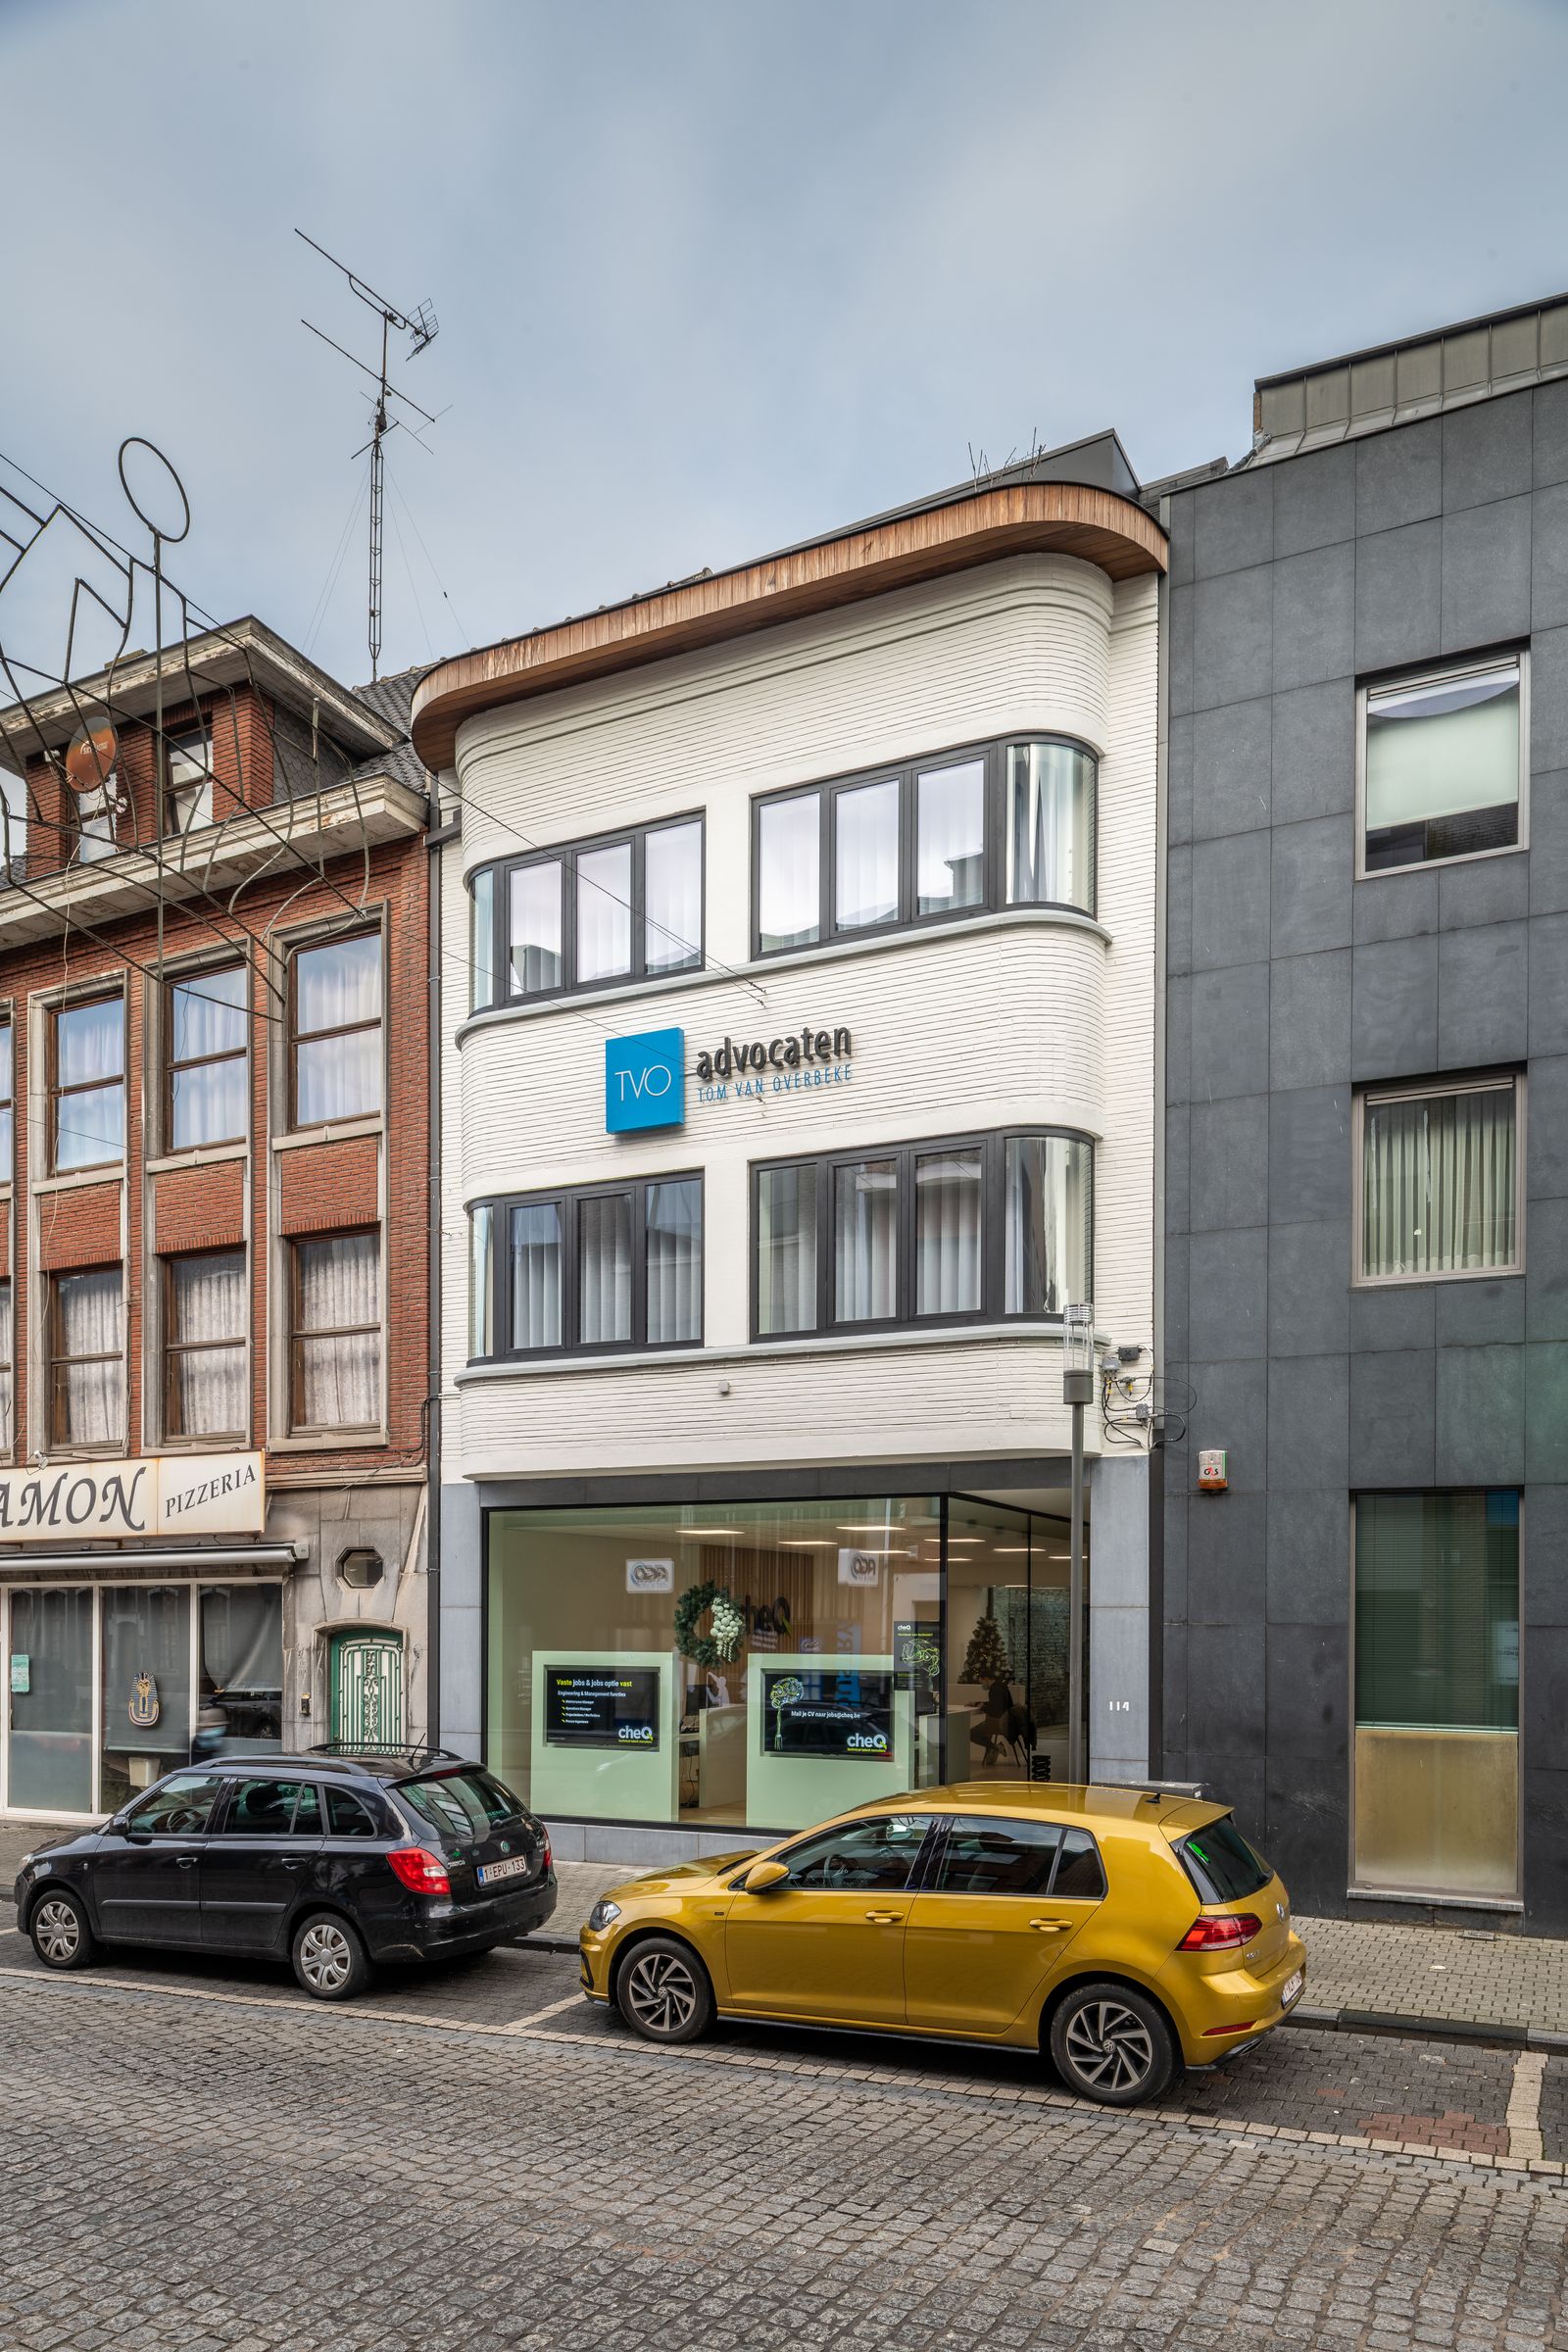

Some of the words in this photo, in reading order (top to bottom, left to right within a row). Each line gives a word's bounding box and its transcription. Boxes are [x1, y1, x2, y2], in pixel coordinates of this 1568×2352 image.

[696, 1026, 852, 1079] advocaten
[614, 1064, 672, 1102] TVO
[698, 1085, 727, 1103] TOM
[736, 1078, 764, 1098] VAN
[773, 1064, 853, 1093] OVERBEKE
[165, 1464, 256, 1518] PIZZERIA
[741, 1594, 792, 1635] heQ
[572, 1679, 585, 1688] jobs
[590, 1679, 604, 1688] jobs
[1109, 1700, 1130, 1711] 114
[618, 1725, 653, 1740] cheQ
[847, 1733, 887, 1750] cheQ
[484, 1858, 525, 1880] 1-EPU-133
